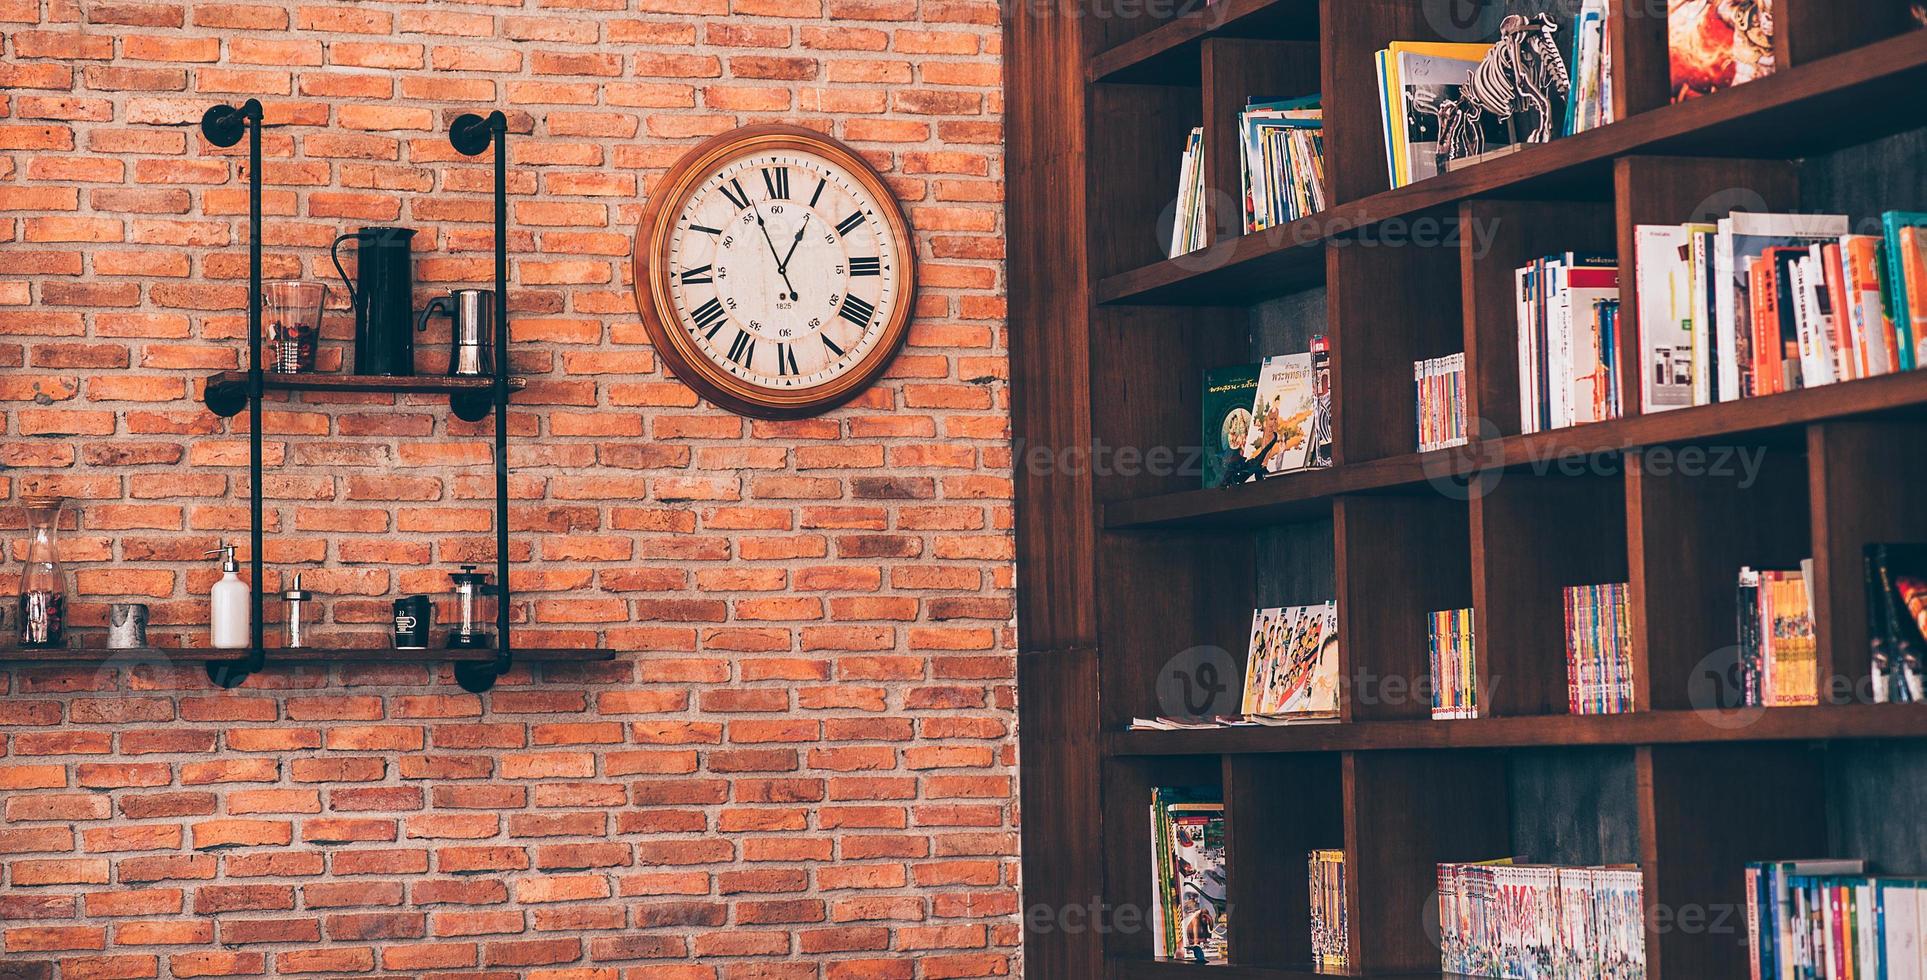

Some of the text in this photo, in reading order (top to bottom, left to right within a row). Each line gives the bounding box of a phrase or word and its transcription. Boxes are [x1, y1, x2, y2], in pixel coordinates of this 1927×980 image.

[761, 167, 791, 201] XII
[718, 177, 752, 216] XI
[770, 205, 784, 215] 60
[742, 213, 755, 226] 55
[834, 210, 867, 238] II
[722, 235, 735, 249] 50
[824, 233, 836, 246] 10
[716, 266, 727, 280] 45
[835, 264, 845, 275] 15
[848, 256, 881, 277] III
[680, 263, 714, 286] IX
[726, 297, 738, 311] 40
[775, 302, 793, 310] 1825
[829, 293, 840, 308] 20
[690, 296, 729, 342] VIII
[749, 319, 763, 332] 35
[808, 319, 821, 330] 25
[778, 328, 792, 338] 30
[726, 328, 757, 370] VII
[819, 331, 847, 364] V
[777, 342, 800, 376] VI
[1271, 365, 1310, 384] พระพุทธเจ้า
